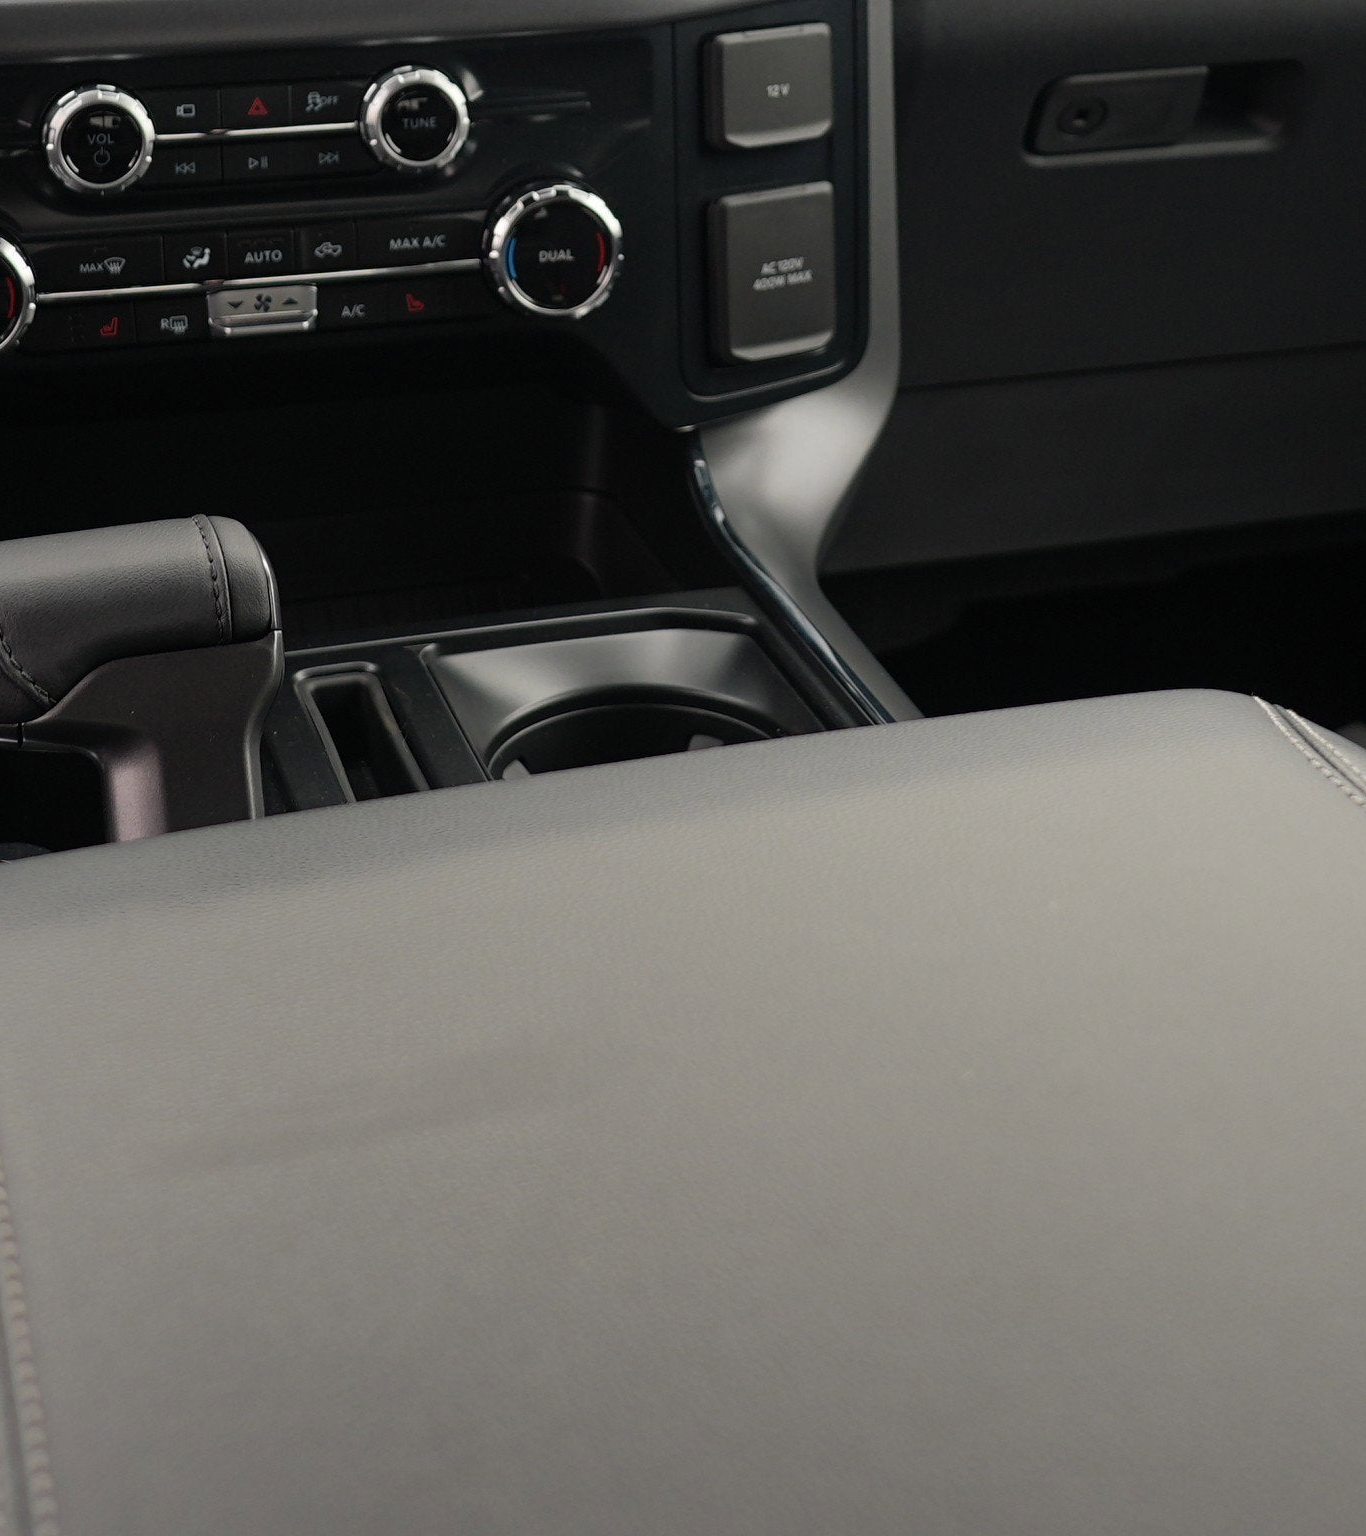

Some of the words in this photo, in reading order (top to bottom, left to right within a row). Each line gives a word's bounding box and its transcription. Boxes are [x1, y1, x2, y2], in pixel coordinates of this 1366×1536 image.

[402, 116, 437, 130] TUNE
[87, 133, 115, 146] VOL
[389, 238, 419, 251] MAX
[422, 234, 446, 248] A/C
[244, 249, 283, 263] AUTO
[538, 249, 575, 263] DUAL
[79, 263, 104, 274] MAX
[341, 304, 366, 318] A/C
